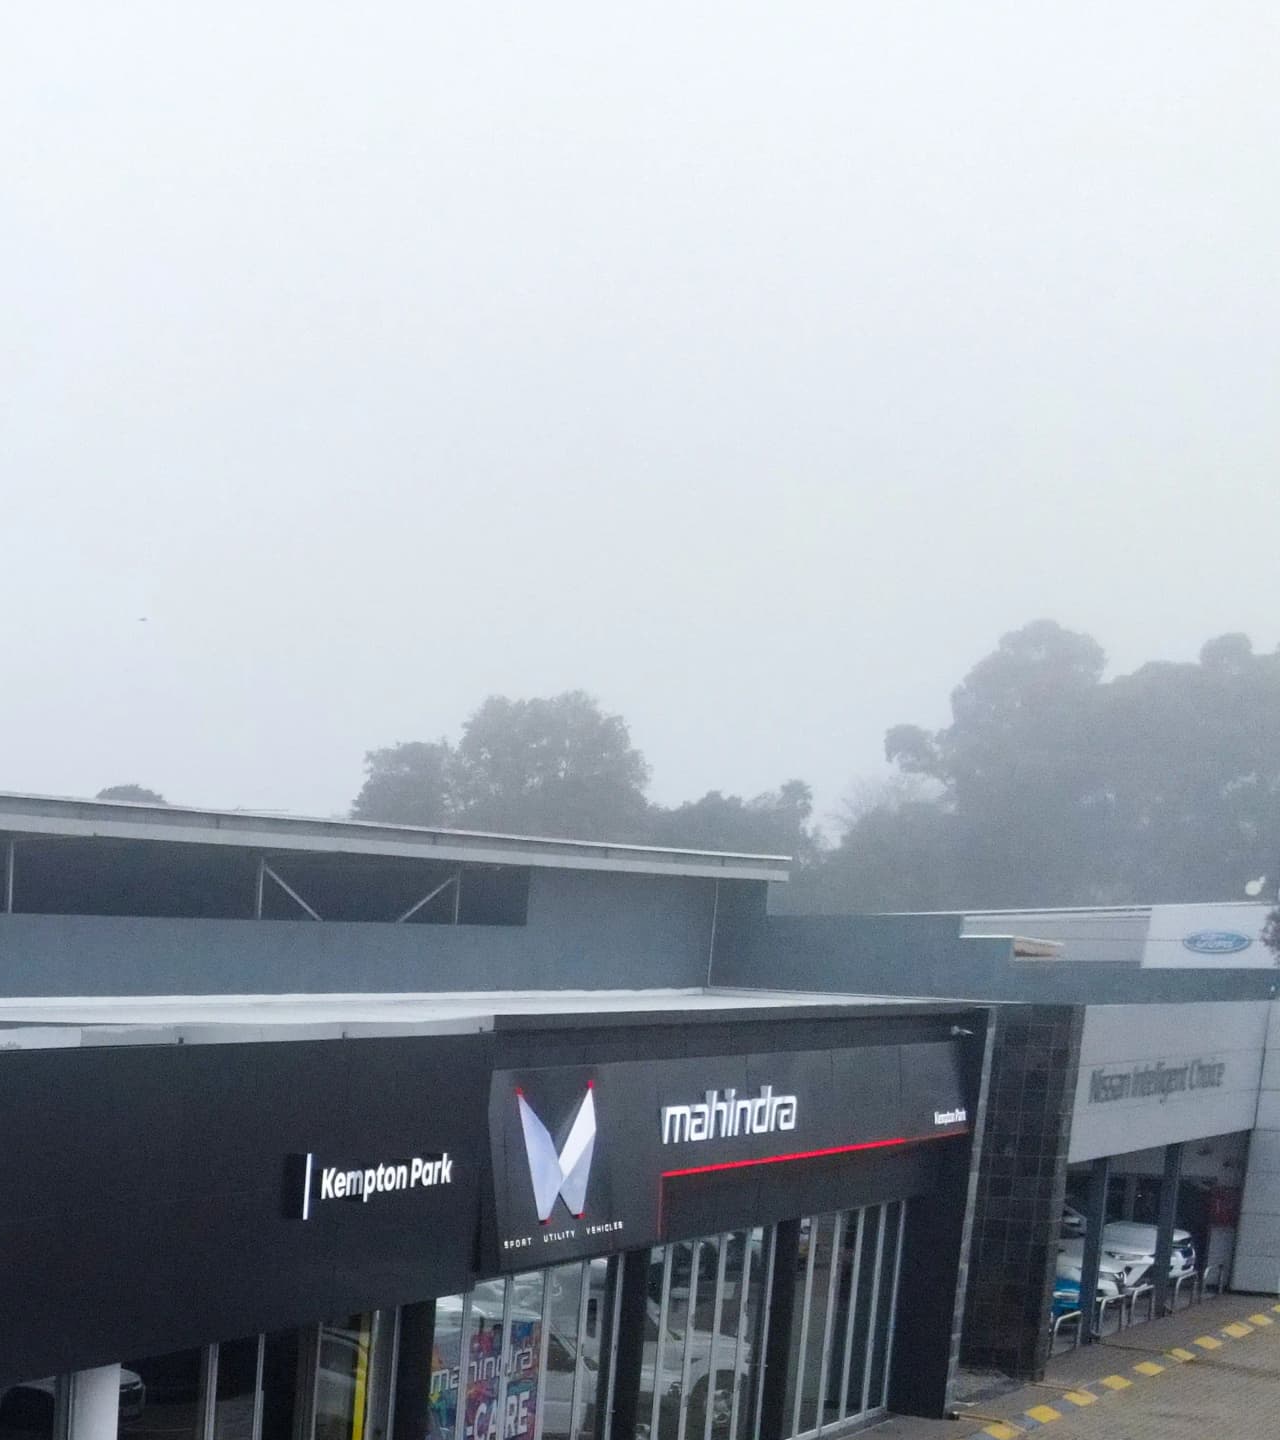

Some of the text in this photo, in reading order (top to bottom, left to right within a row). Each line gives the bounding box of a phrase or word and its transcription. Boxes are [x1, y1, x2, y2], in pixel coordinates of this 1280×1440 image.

[662, 1085, 797, 1145] mahindra
[320, 1152, 453, 1203] Kempton Park
[503, 1220, 624, 1249] SPORT UTILITY VEHICLES
